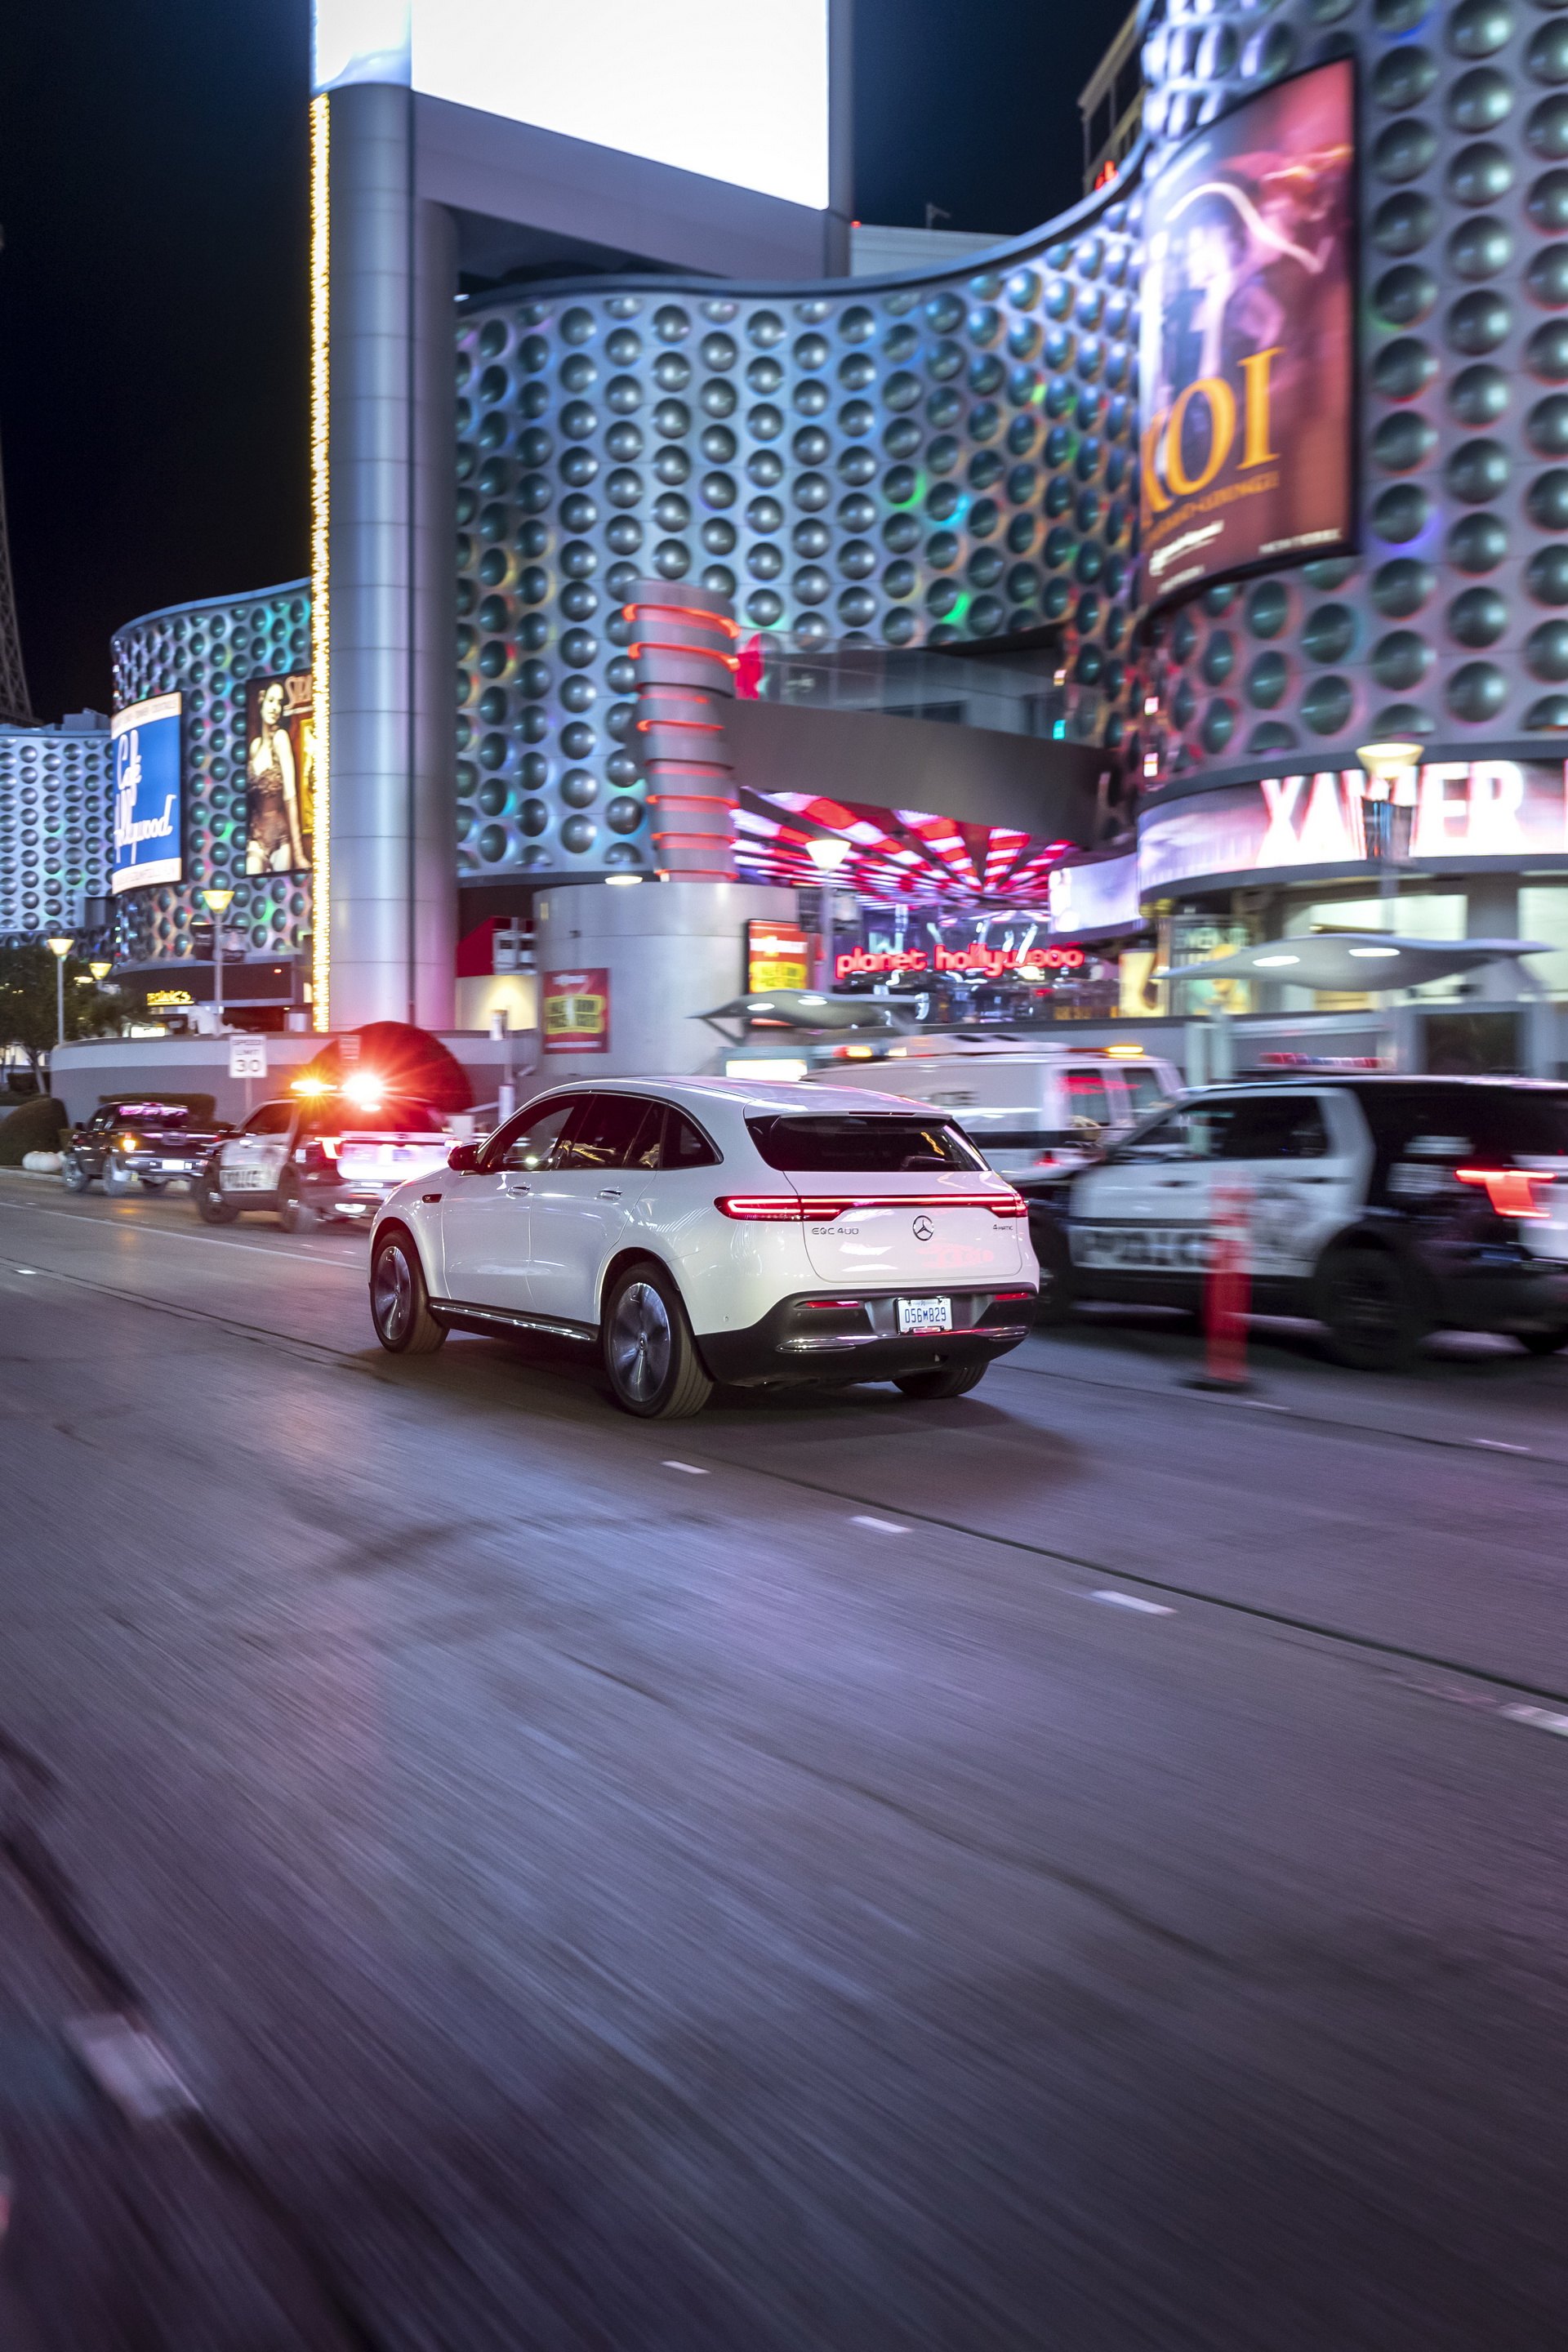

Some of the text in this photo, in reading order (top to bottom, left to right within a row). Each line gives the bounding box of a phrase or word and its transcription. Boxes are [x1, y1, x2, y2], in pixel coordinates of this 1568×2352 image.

[835, 947, 929, 980] planet
[236, 1059, 261, 1071] 30
[812, 1227, 835, 1235] EQC
[904, 1307, 947, 1323] 056M829
